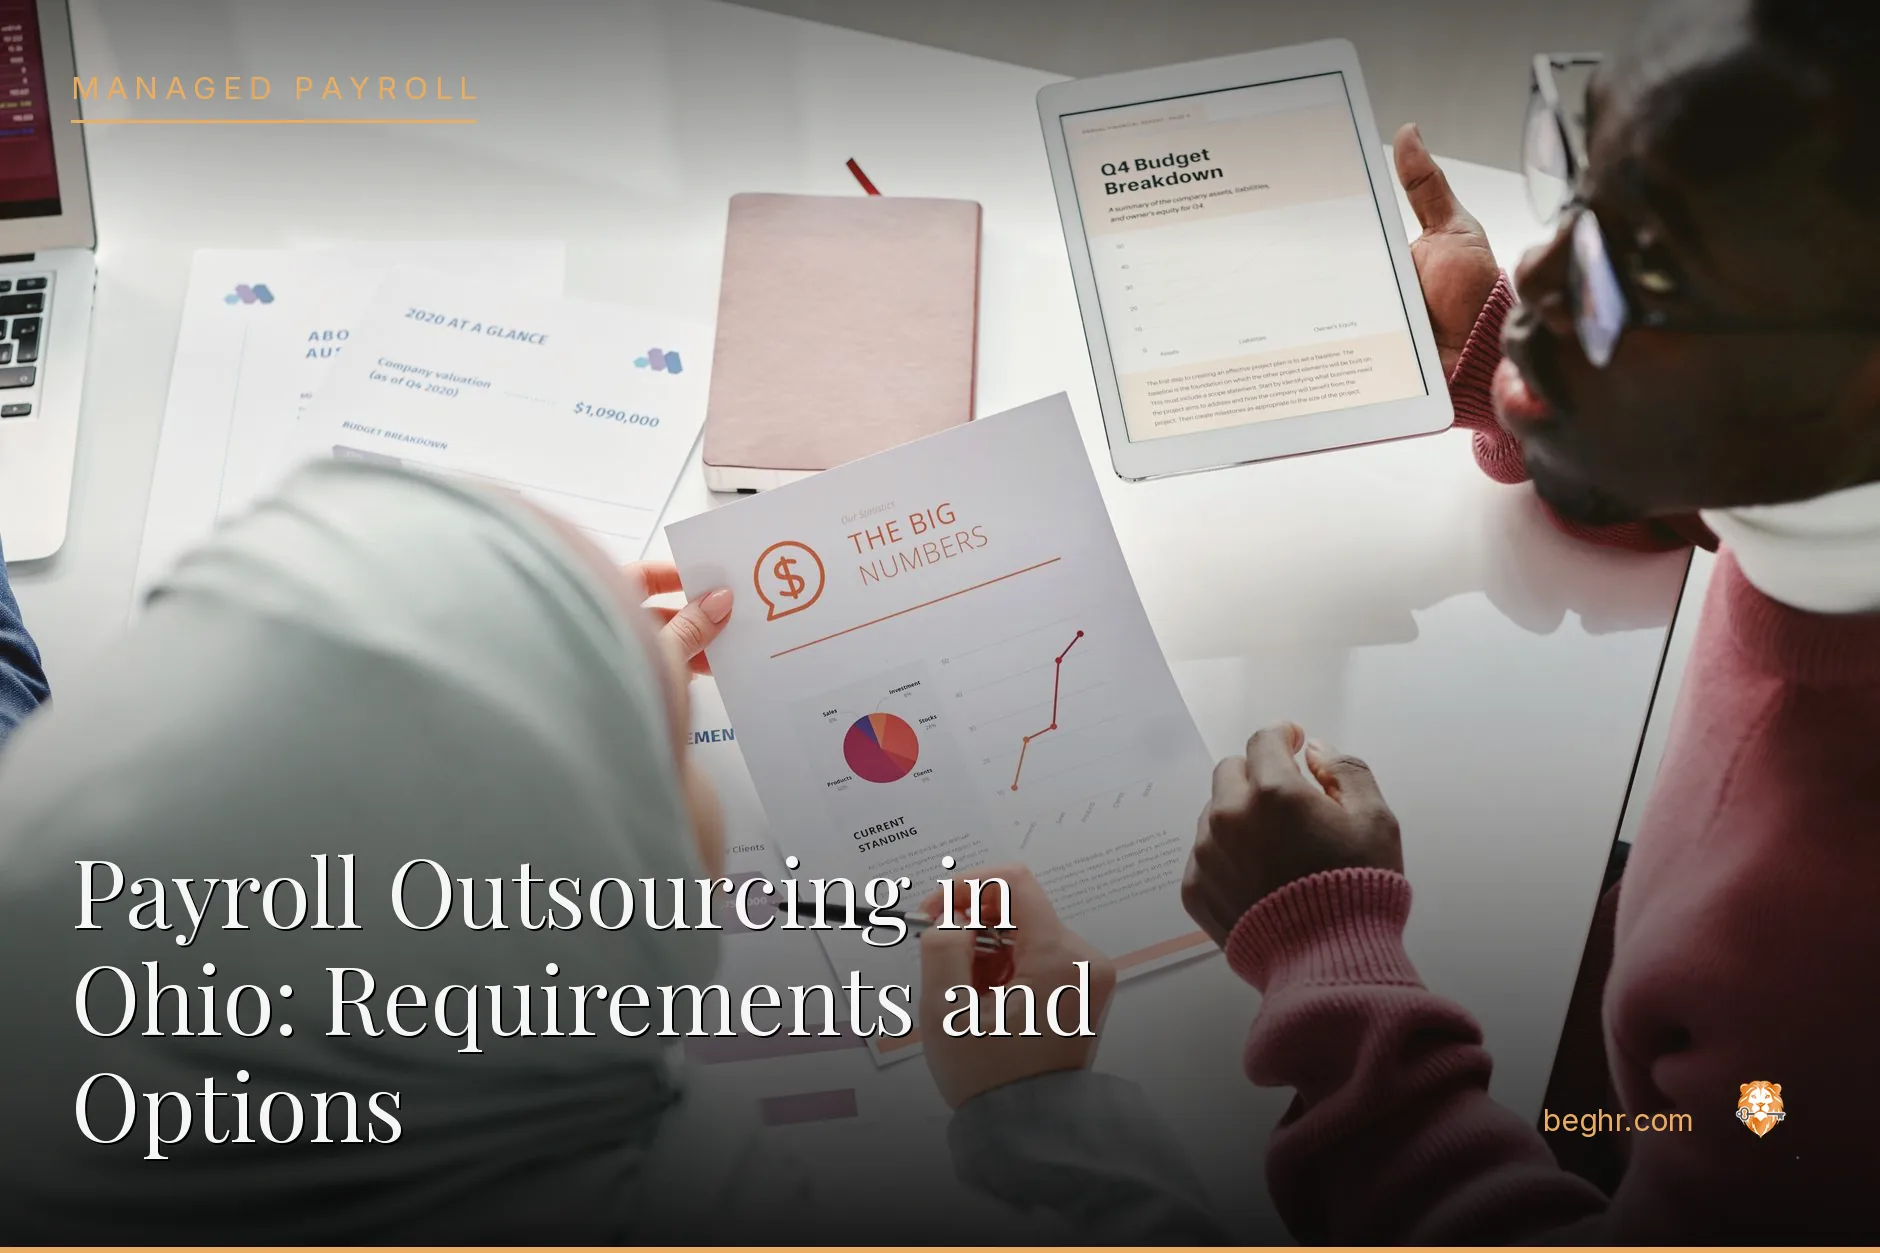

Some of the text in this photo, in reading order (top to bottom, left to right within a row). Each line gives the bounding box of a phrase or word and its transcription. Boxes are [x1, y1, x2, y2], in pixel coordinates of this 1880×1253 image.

[1100, 147, 1211, 177] Q4 Budget
[1104, 164, 1224, 195] Breakdown
[1110, 215, 1124, 223] and
[1155, 206, 1179, 216] equity
[1114, 202, 1149, 212] summary
[1172, 193, 1207, 203] company
[404, 307, 550, 346] 2020 AT A GLANCE
[369, 370, 459, 398] (as of Q4 2020)
[377, 356, 492, 389] Company valuation
[573, 401, 660, 428] $1,090,000
[342, 420, 448, 450] BUDGET BREAKDOWN
[841, 500, 896, 526] Our Statistics
[847, 502, 956, 554] THE BIG
[858, 525, 989, 586] NUMBERS
[888, 680, 921, 695] Investment
[822, 708, 838, 718] Sales
[918, 714, 938, 725] Stocks
[827, 775, 853, 788] Products
[913, 768, 933, 778] Clients
[853, 816, 905, 841] CURRENT
[858, 826, 918, 853] STANDING
[732, 843, 765, 854] Clients
